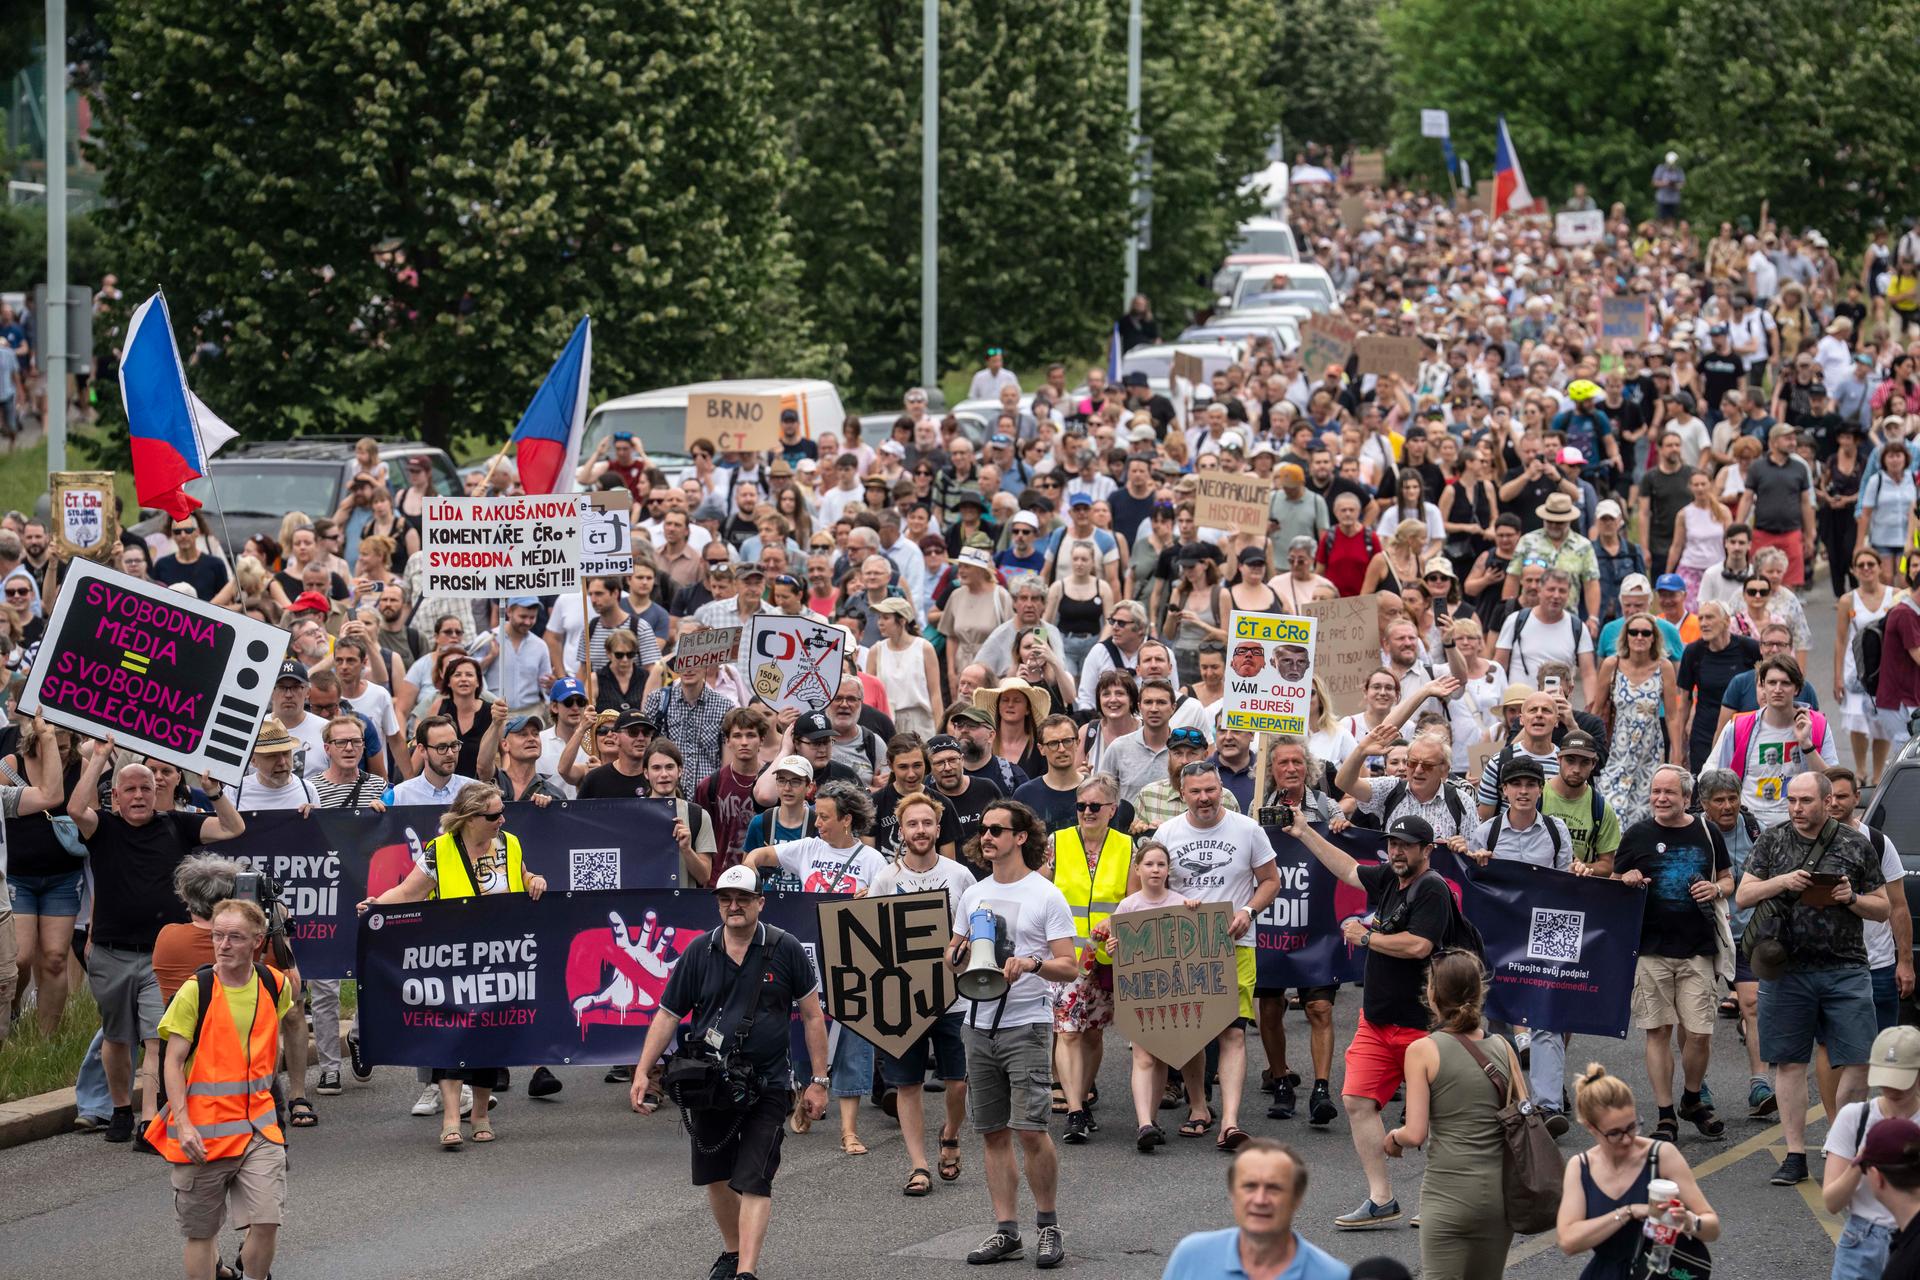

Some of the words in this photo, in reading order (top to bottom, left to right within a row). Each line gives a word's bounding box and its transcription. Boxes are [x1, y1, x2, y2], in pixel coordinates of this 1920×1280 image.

[707, 399, 763, 422] BRNO
[1198, 478, 1270, 505] NEOPAKUJME
[428, 500, 464, 521] LÍDA
[472, 498, 578, 521] RAKUŠANOVÁ
[429, 523, 524, 545] KOMENTÁŘE
[589, 530, 607, 544] ČT
[429, 546, 515, 568] SVOBODNÁ
[521, 544, 567, 567] MÉDIA
[429, 571, 487, 591] PROSÍM
[495, 568, 575, 591] NERUŠIT!!!
[86, 582, 225, 648] SVOBODNÁ
[1237, 616, 1259, 636] ČT
[1262, 627, 1271, 637] a
[1276, 620, 1309, 641] ČRo
[95, 616, 177, 666] MÉDIA
[57, 651, 204, 720] SVOBODNÁ
[759, 669, 772, 679] 150
[1231, 680, 1258, 695] VÁM
[1271, 685, 1306, 699] OLDO
[40, 675, 203, 752] SPOLEČNOST
[1240, 700, 1247, 709] a
[1250, 698, 1294, 714] BUREŠI
[1176, 840, 1237, 859] ANCHORAGE
[1199, 852, 1213, 860] US
[273, 850, 341, 879] PRYČ
[836, 862, 861, 876] PYČ
[277, 880, 340, 916] ÉDIÍ
[290, 919, 337, 939] UŽBY
[837, 899, 944, 968] NE
[1258, 931, 1309, 950] SLUŽBY
[402, 943, 467, 970] RUCE
[472, 933, 537, 965] PRYČ
[1508, 962, 1541, 973] Připojte
[1542, 966, 1559, 977] svůj
[1560, 969, 1590, 979] podpis!
[402, 977, 446, 1006] OD
[452, 963, 537, 1005] MÉDIÍ
[831, 961, 945, 1037] BOJ
[402, 1008, 477, 1028] VEŘEJNÉ
[480, 1006, 537, 1027] SLUŽBY
